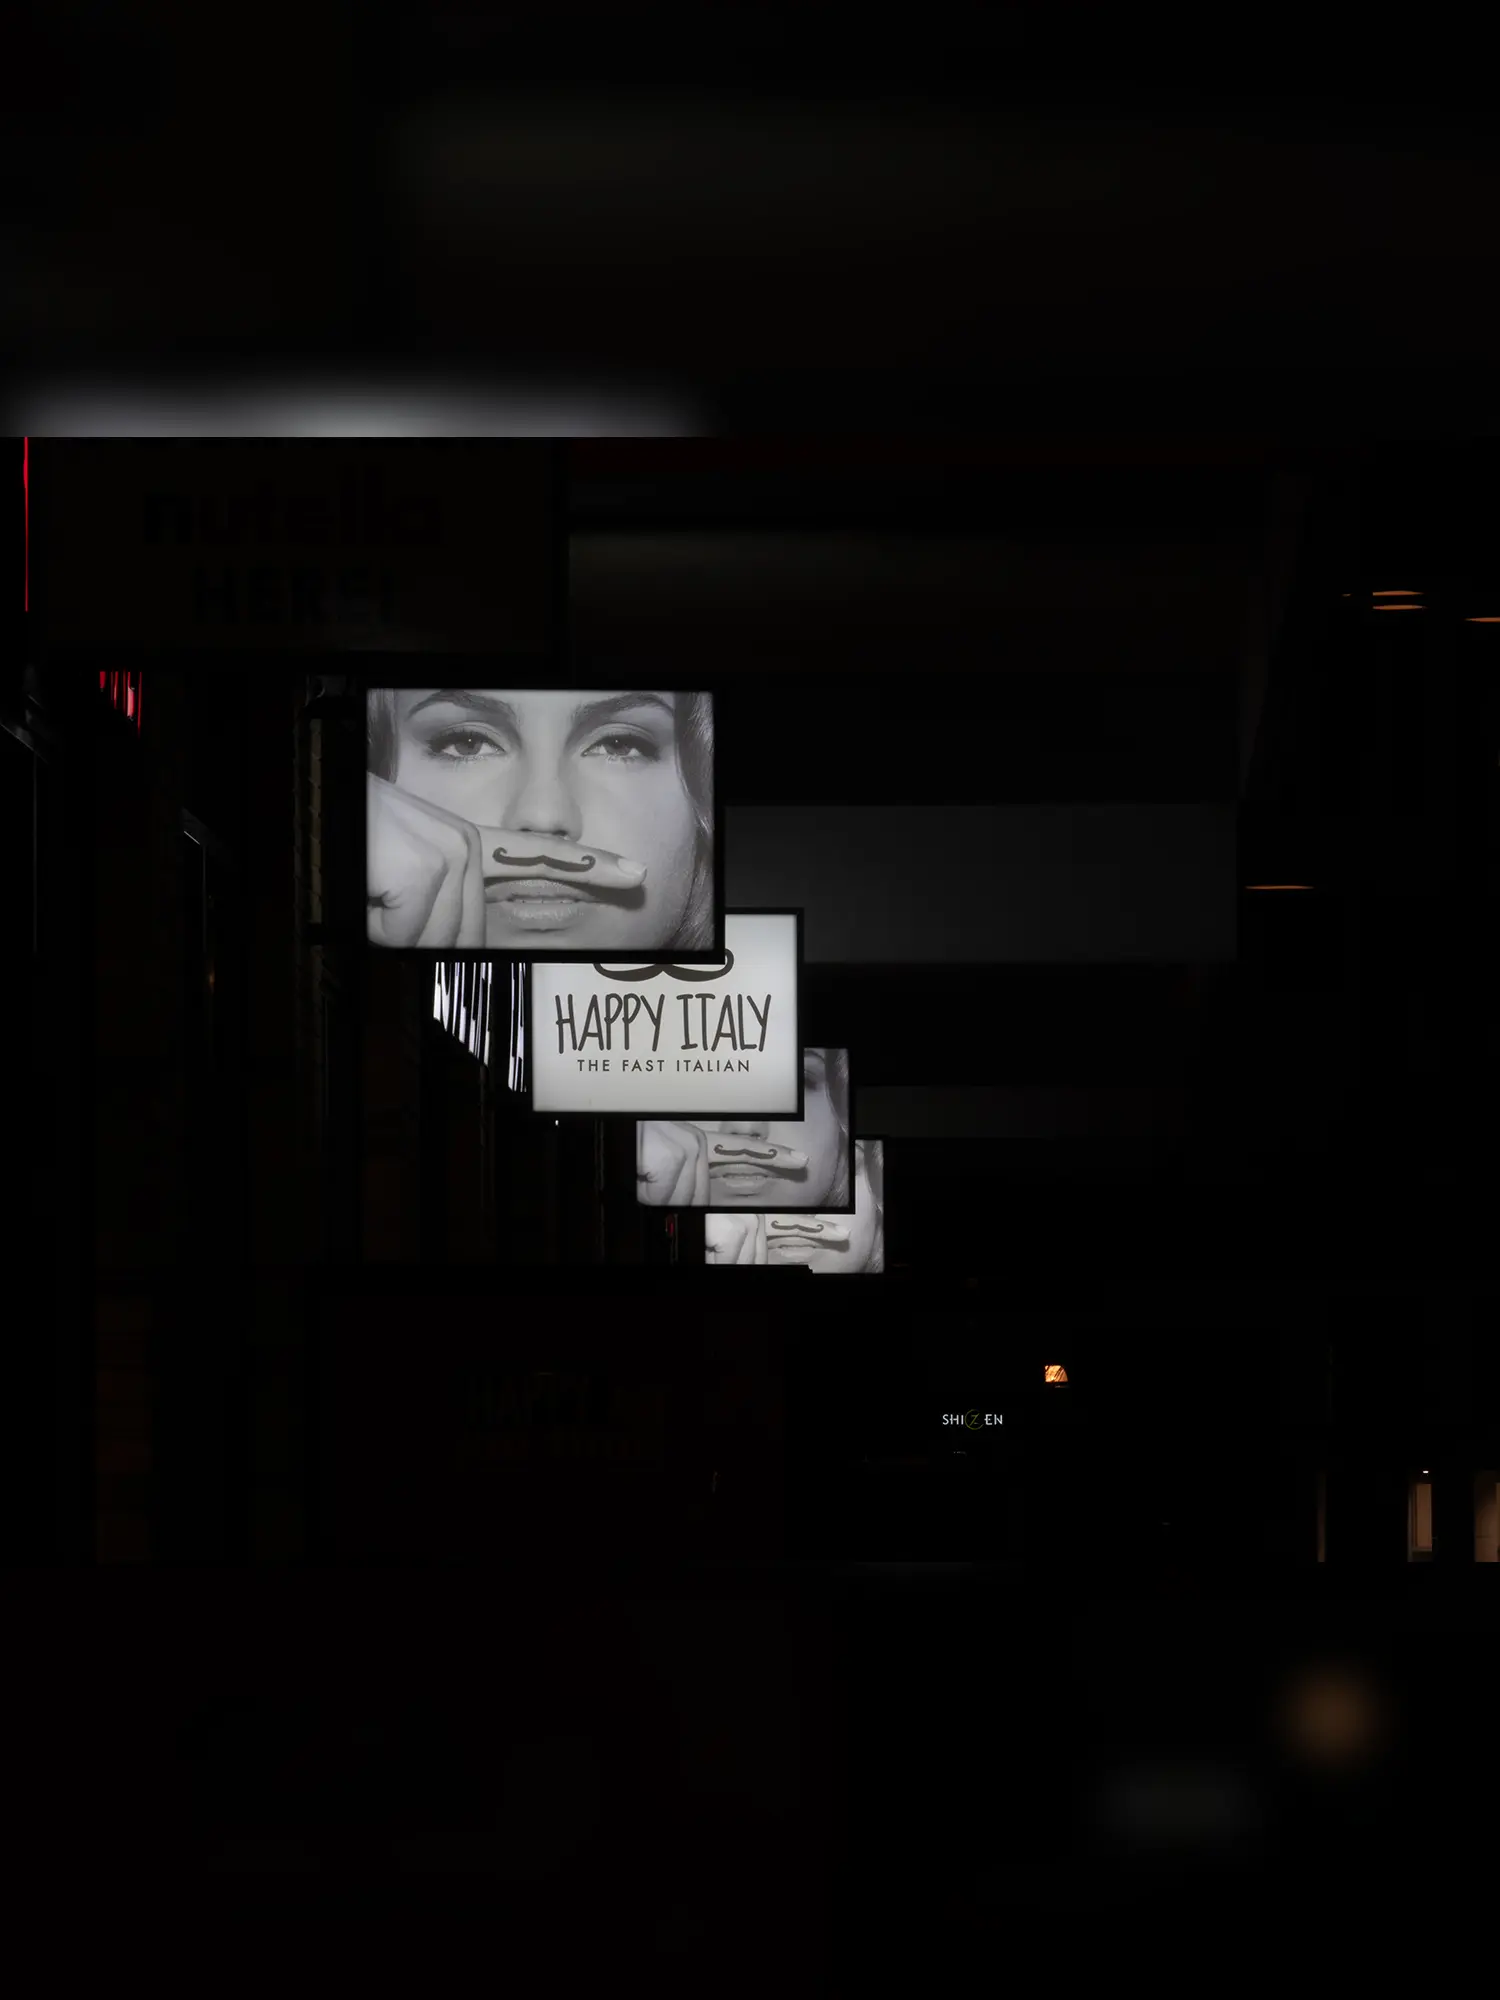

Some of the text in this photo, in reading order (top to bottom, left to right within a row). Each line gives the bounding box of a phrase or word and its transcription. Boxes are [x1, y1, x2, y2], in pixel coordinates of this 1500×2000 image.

[143, 463, 443, 545] nutella
[555, 993, 772, 1054] HAPPY ITALY
[577, 1059, 750, 1072] THE FAST ITALIAN
